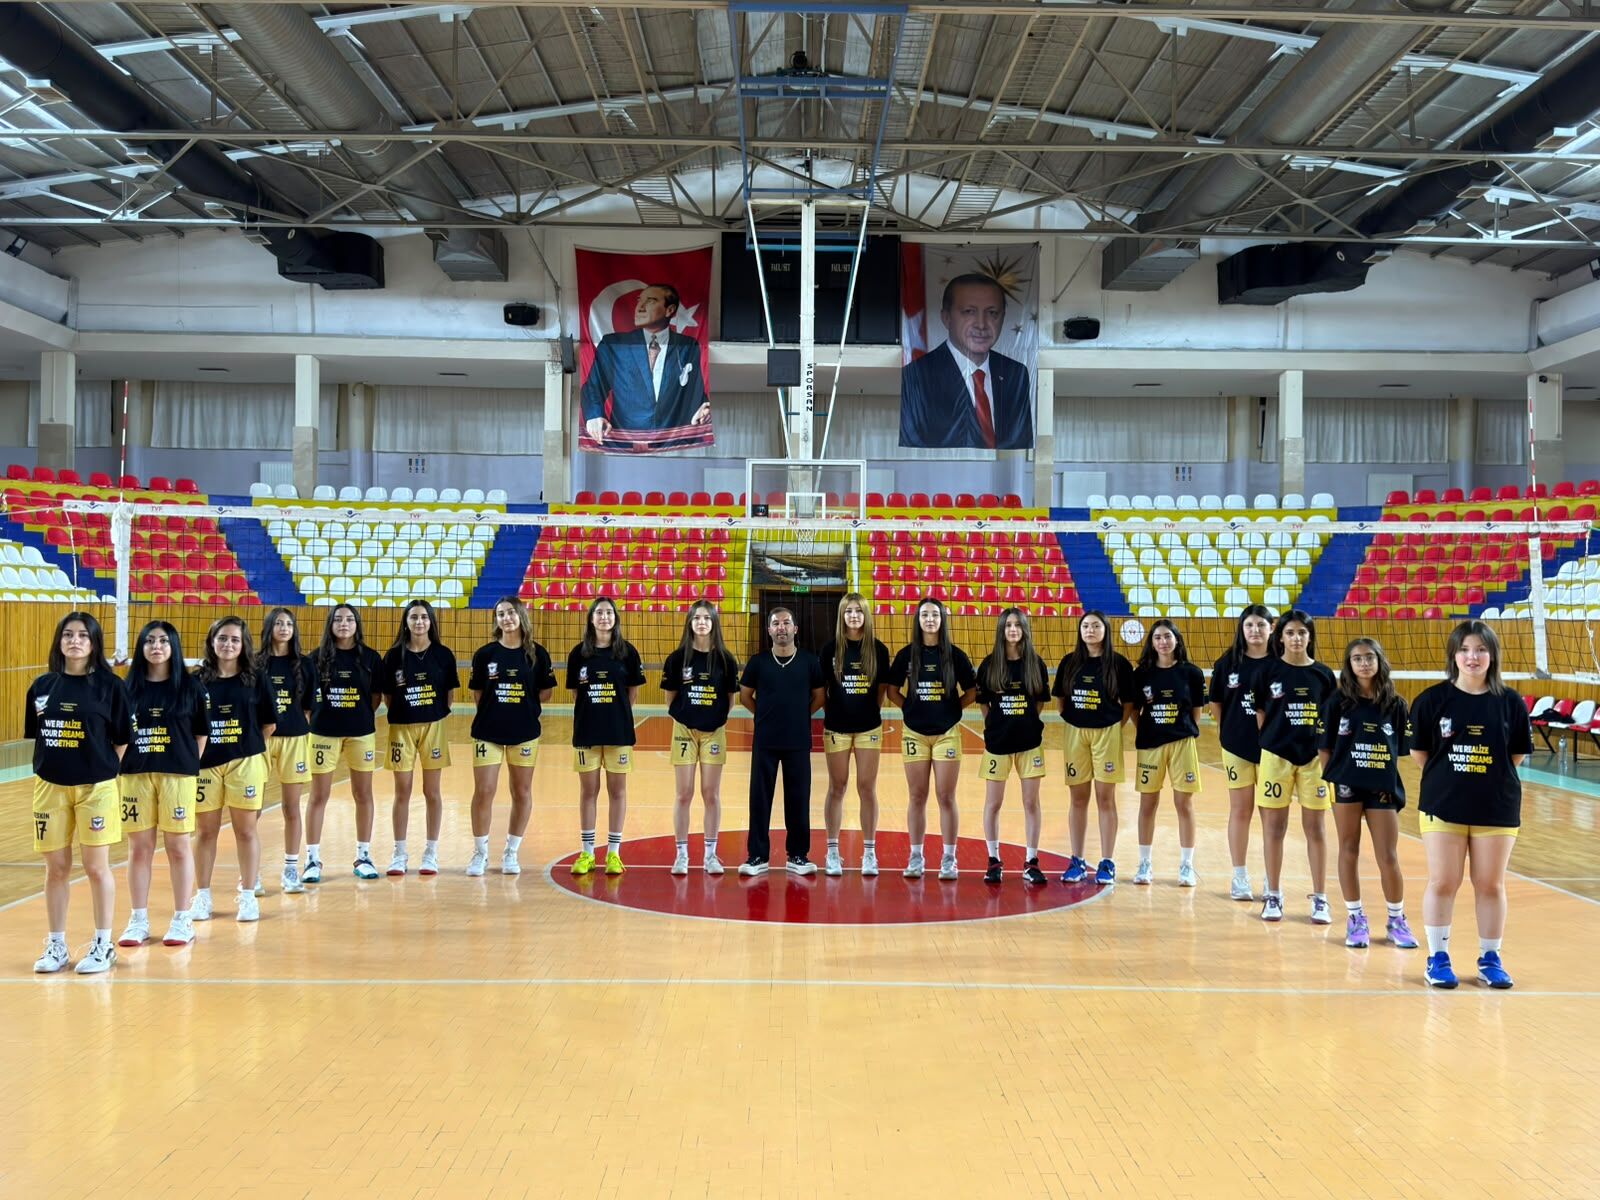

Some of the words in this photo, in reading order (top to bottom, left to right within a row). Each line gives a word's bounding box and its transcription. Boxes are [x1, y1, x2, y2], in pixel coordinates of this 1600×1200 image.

[45, 720, 55, 728] WE
[41, 728, 57, 738] YOUR
[58, 730, 85, 739] DREAMS
[46, 739, 79, 748] TOGETHER
[138, 745, 165, 753] TOGETHER
[681, 743, 687, 757] 7
[906, 742, 916, 755] 13
[1453, 744, 1463, 752] WE
[391, 748, 401, 763] 18
[476, 744, 487, 757] 14
[1351, 751, 1366, 759] YOUR
[316, 750, 324, 765] 8
[579, 751, 585, 765] 11
[1448, 753, 1465, 762] YOUR
[1466, 755, 1492, 764] DREAMS
[989, 759, 996, 774] 2
[1356, 760, 1385, 769] TOGETHER
[1453, 764, 1486, 773] TOGETHER
[1141, 771, 1149, 784] 5
[1264, 781, 1282, 798] 20
[121, 804, 138, 822] 34
[36, 820, 47, 840] 17
